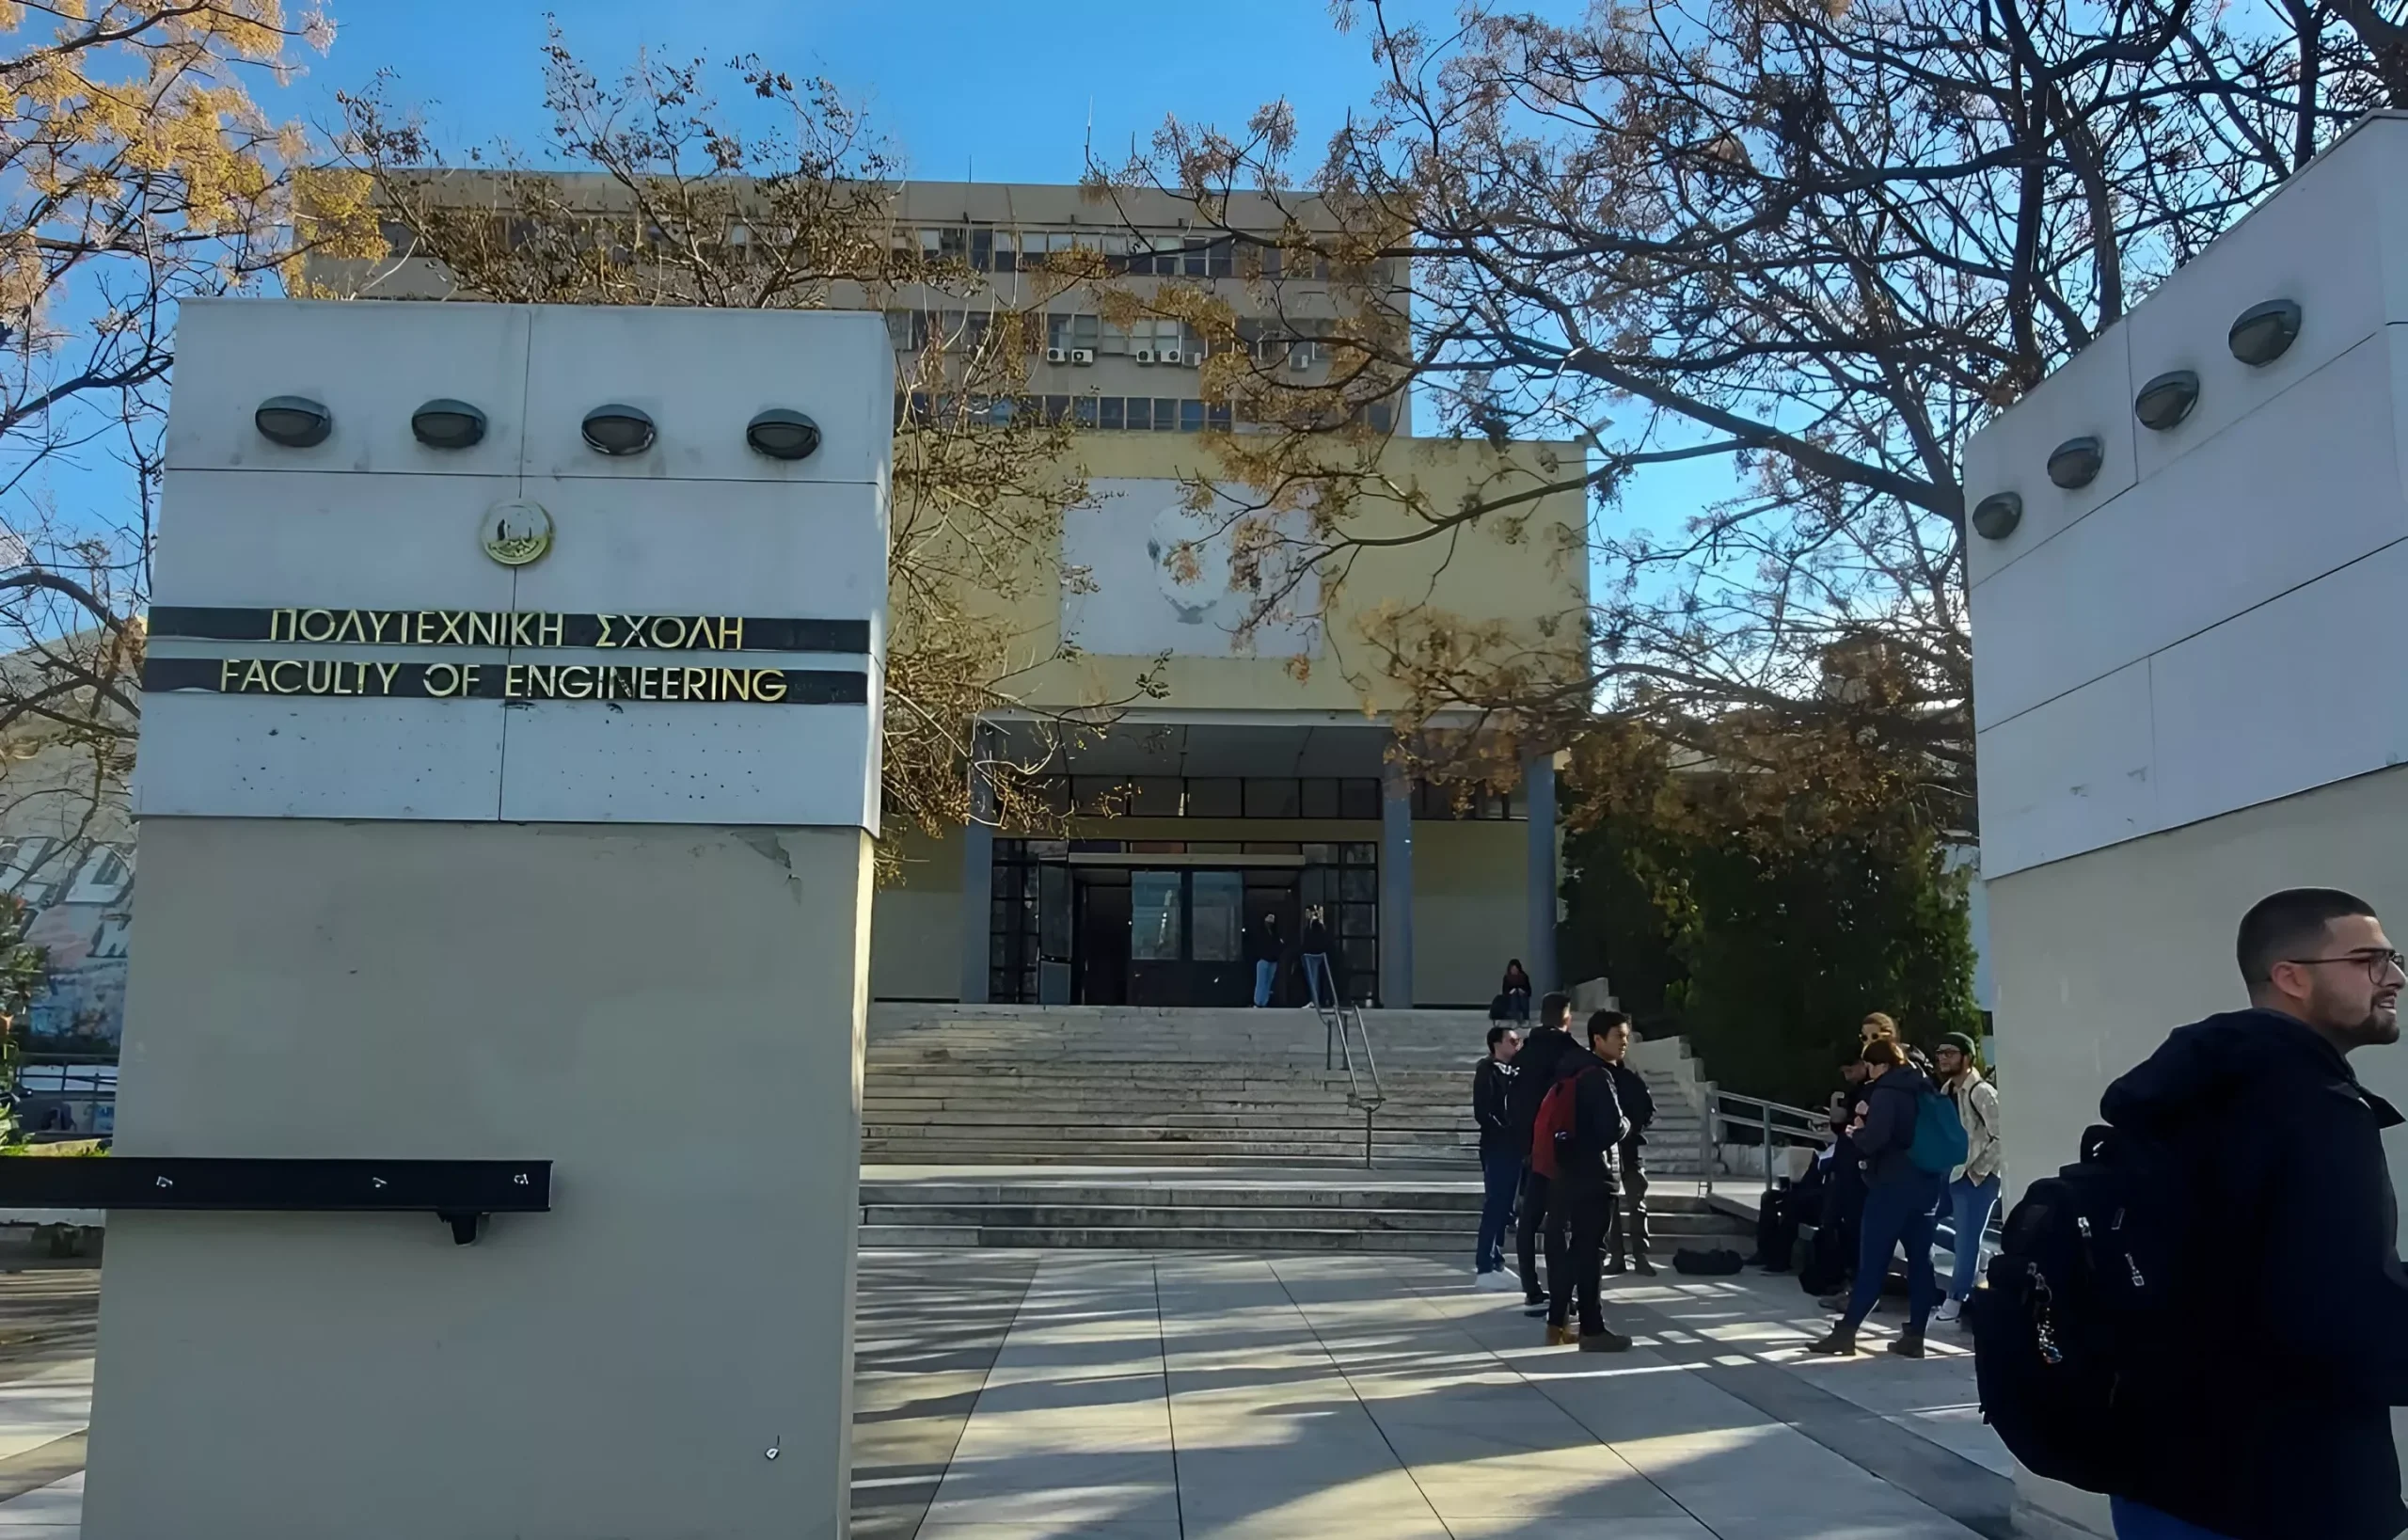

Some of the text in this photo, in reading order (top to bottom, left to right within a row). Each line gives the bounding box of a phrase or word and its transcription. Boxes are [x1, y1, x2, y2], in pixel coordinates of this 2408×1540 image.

[595, 613, 743, 650] ΣΧΟΛΗ
[220, 659, 788, 702] FACULTY OF ENGINEERING
